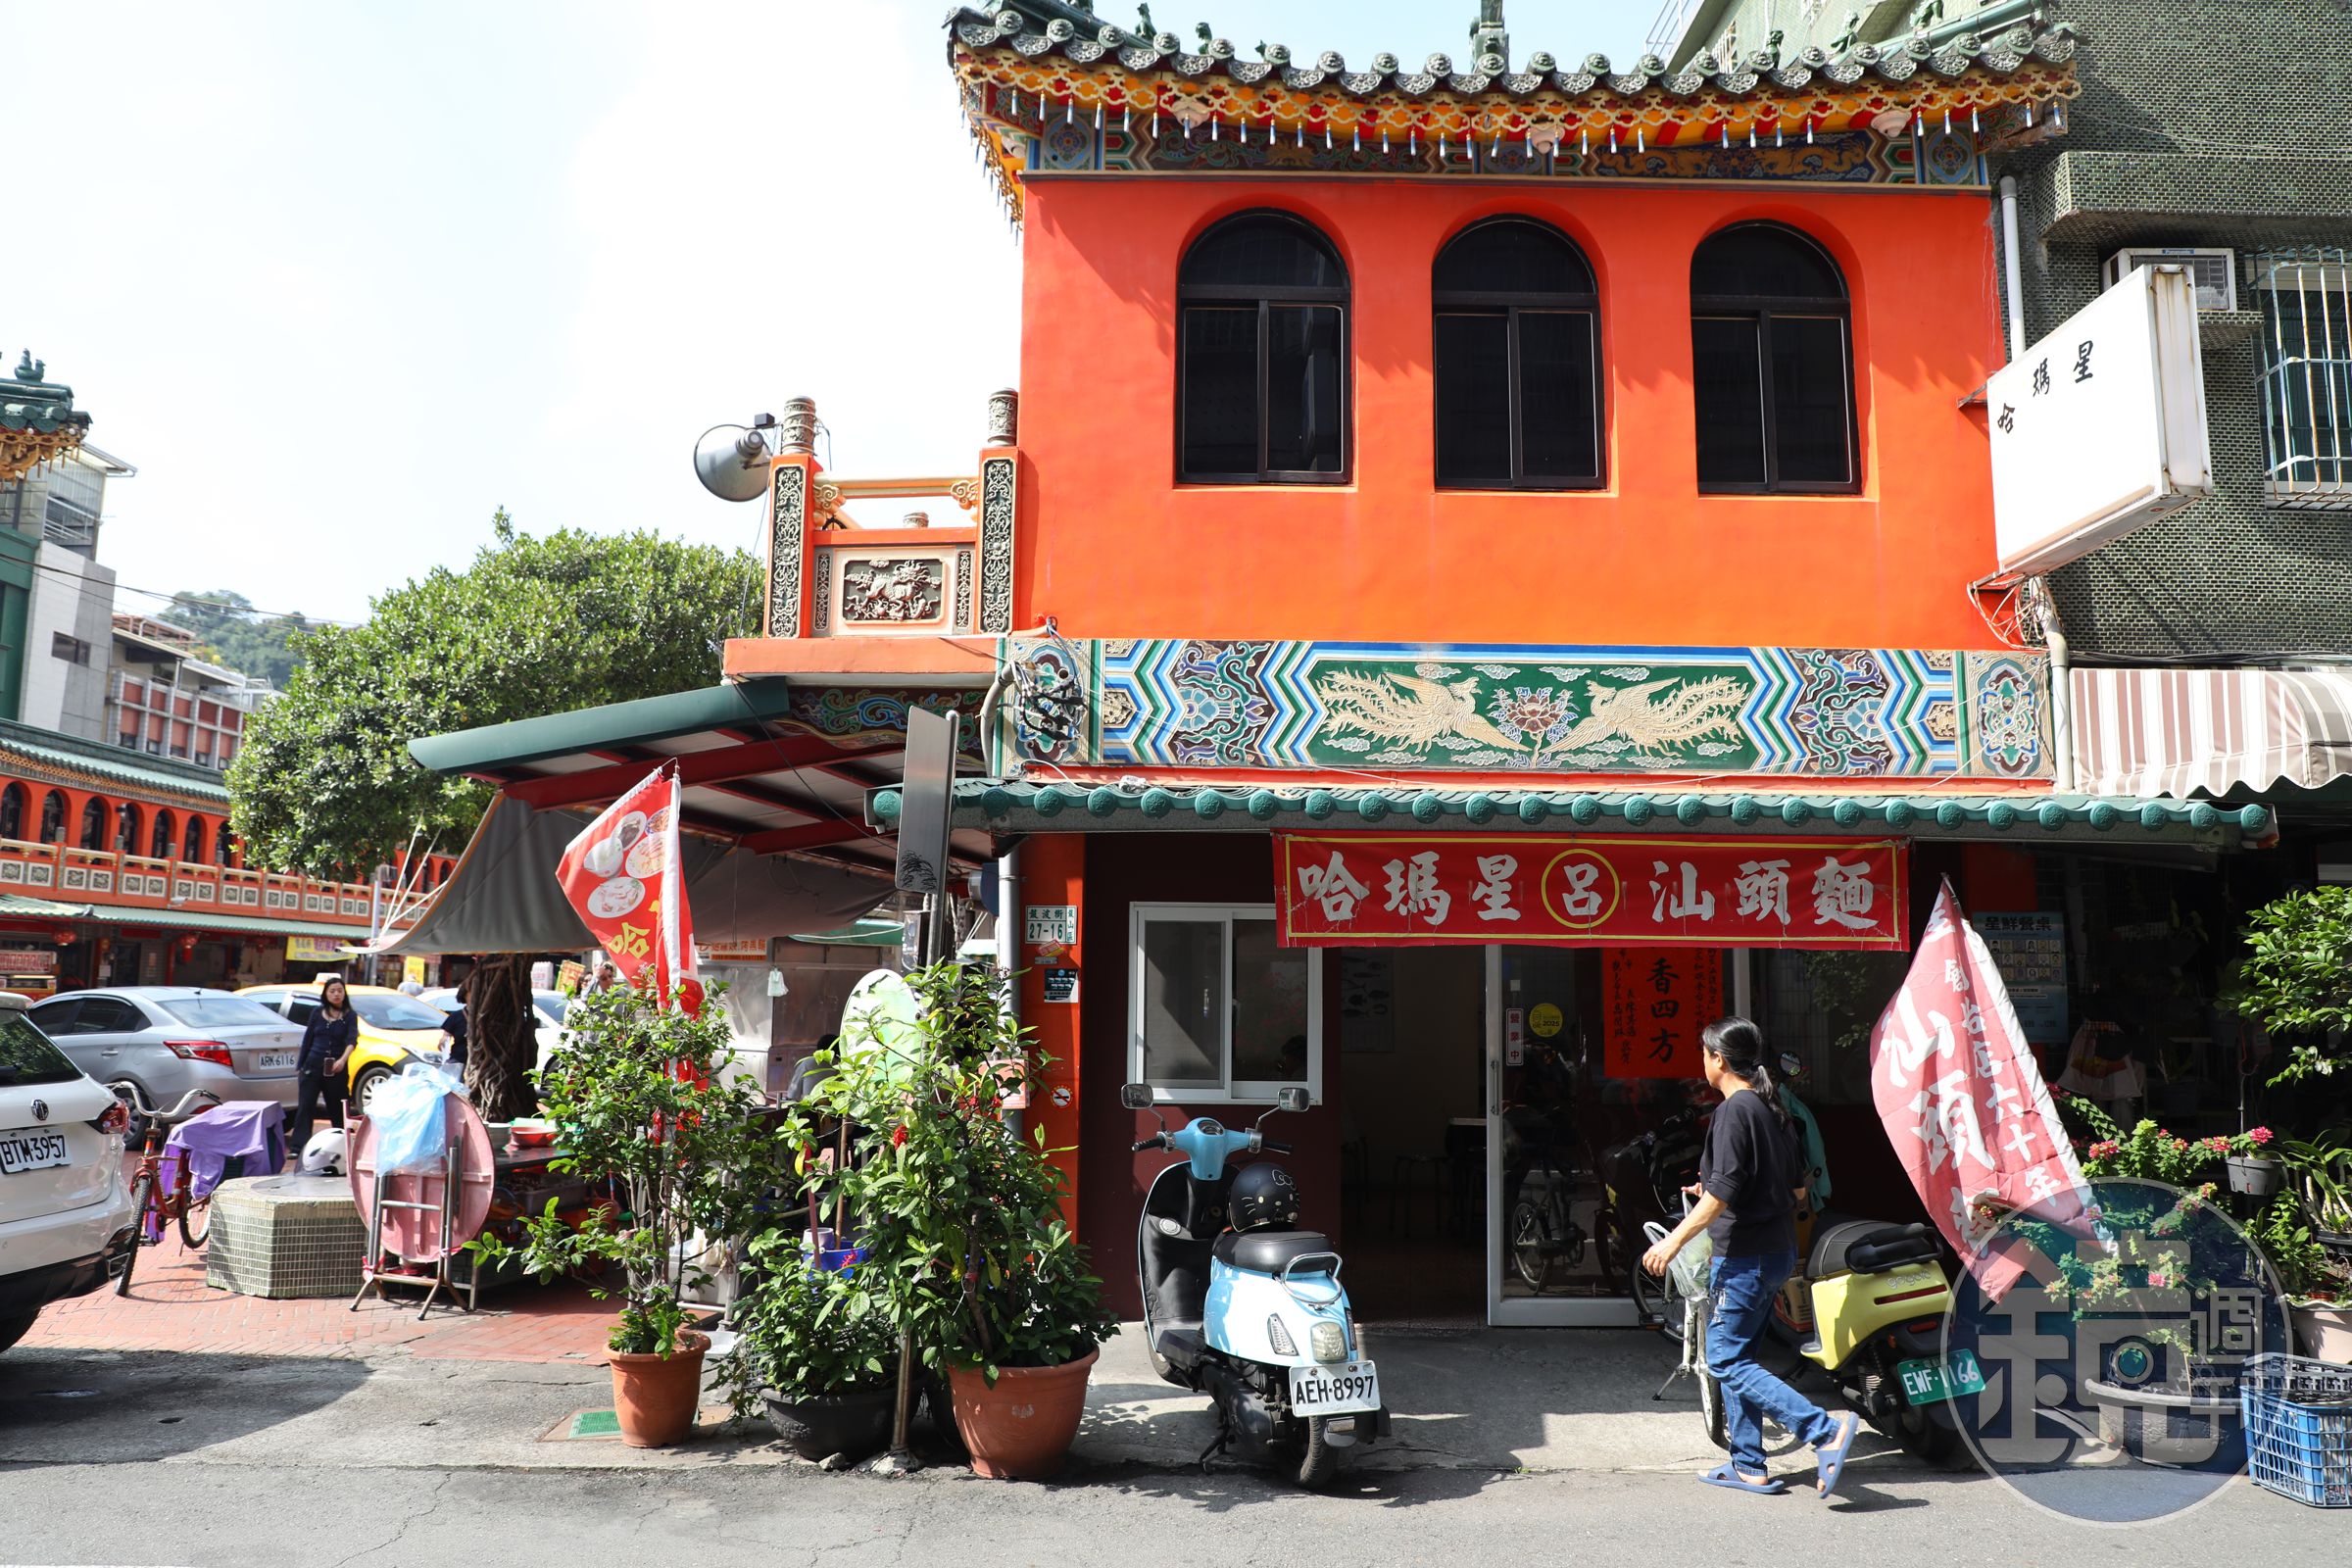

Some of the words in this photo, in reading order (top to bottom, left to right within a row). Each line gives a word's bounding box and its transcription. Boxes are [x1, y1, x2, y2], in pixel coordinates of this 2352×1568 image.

[1997, 340, 2093, 434] 哈瑪星
[1029, 922, 1063, 939] 27-16
[1984, 916, 2052, 931] 星鮮餐桌
[1510, 1012, 1520, 1060] 營業中
